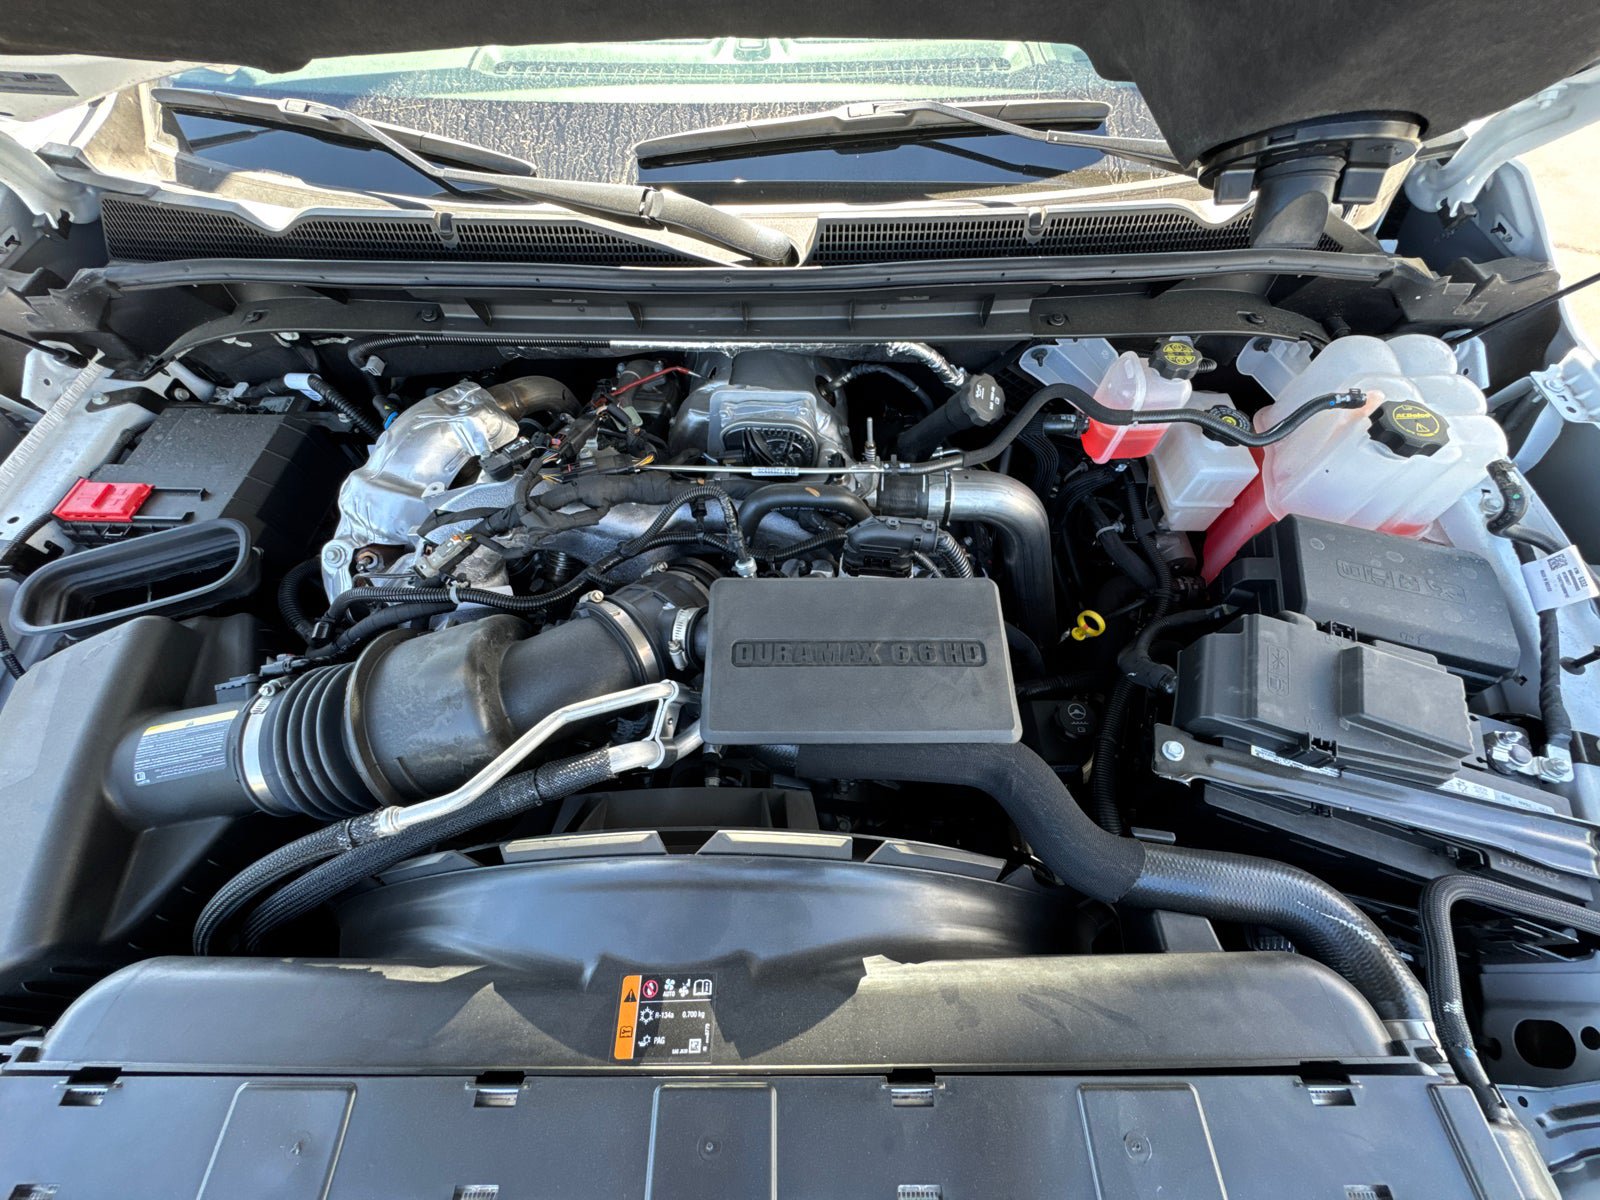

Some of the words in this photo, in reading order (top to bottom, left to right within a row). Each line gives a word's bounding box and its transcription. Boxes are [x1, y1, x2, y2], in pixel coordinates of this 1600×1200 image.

[735, 643, 881, 664] DURAMAX
[891, 643, 937, 663] 6.6
[943, 643, 983, 663] HD
[698, 1010, 705, 1018] kg
[654, 1036, 665, 1045] PAG
